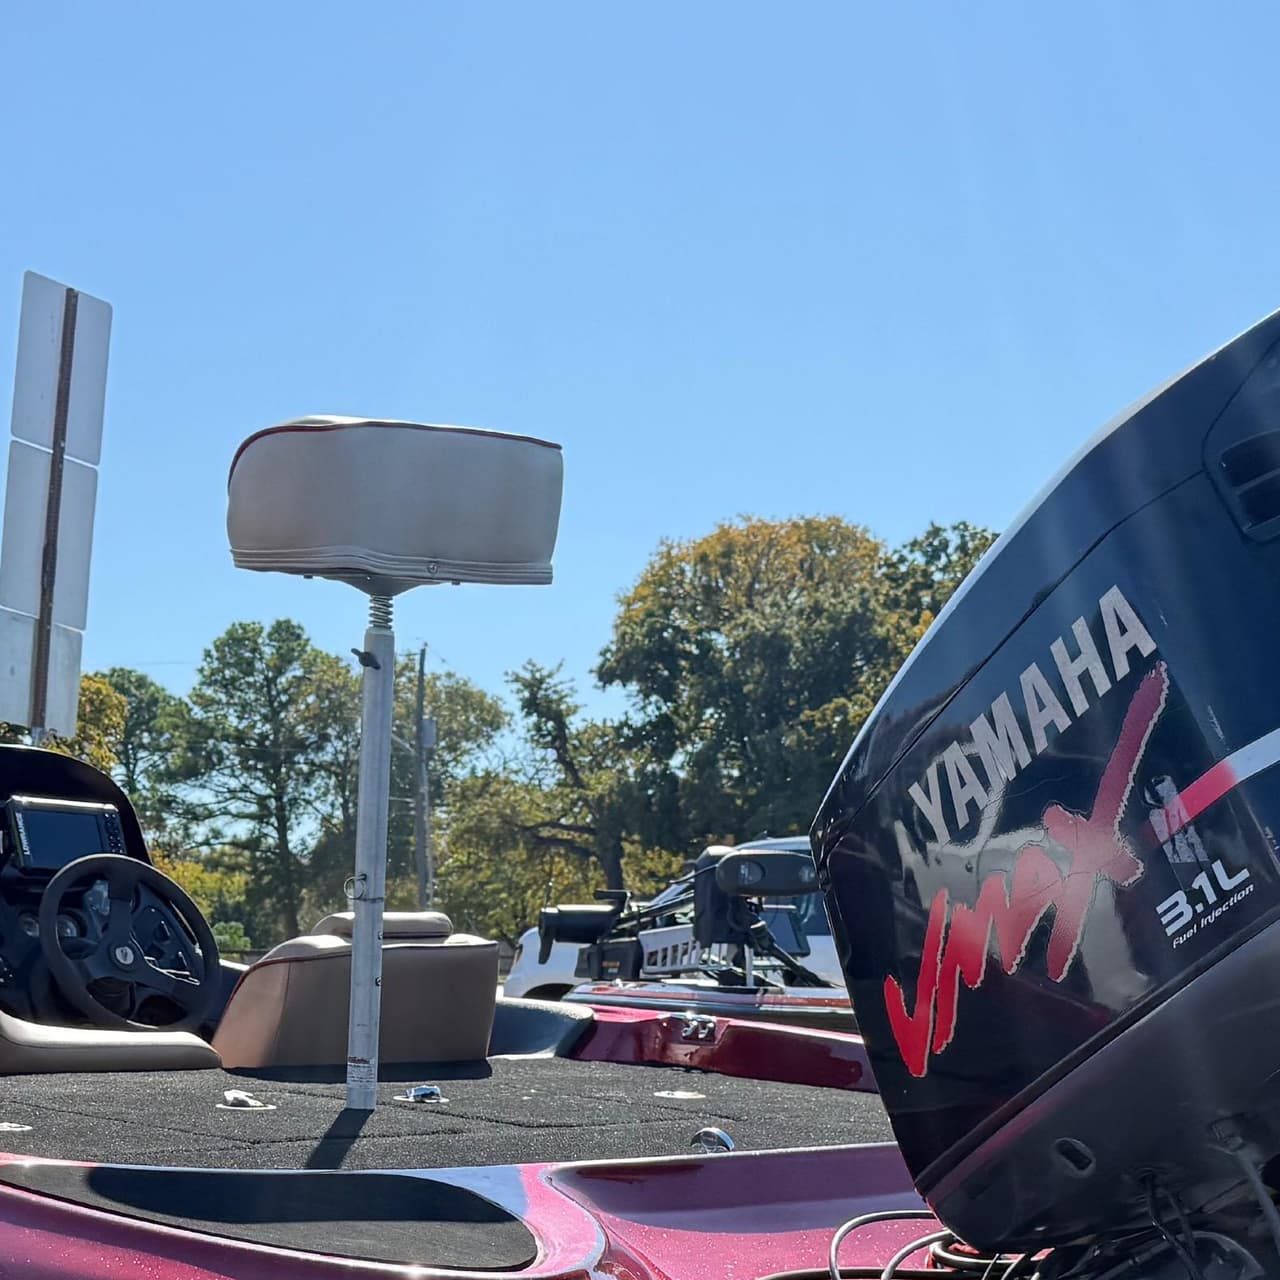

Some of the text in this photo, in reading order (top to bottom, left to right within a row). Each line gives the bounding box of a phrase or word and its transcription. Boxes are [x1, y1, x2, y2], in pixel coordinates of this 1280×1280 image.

[908, 584, 1158, 847] YAMAHA
[1155, 859, 1251, 937] 3.1L
[1172, 884, 1255, 949] Fuel Injection
